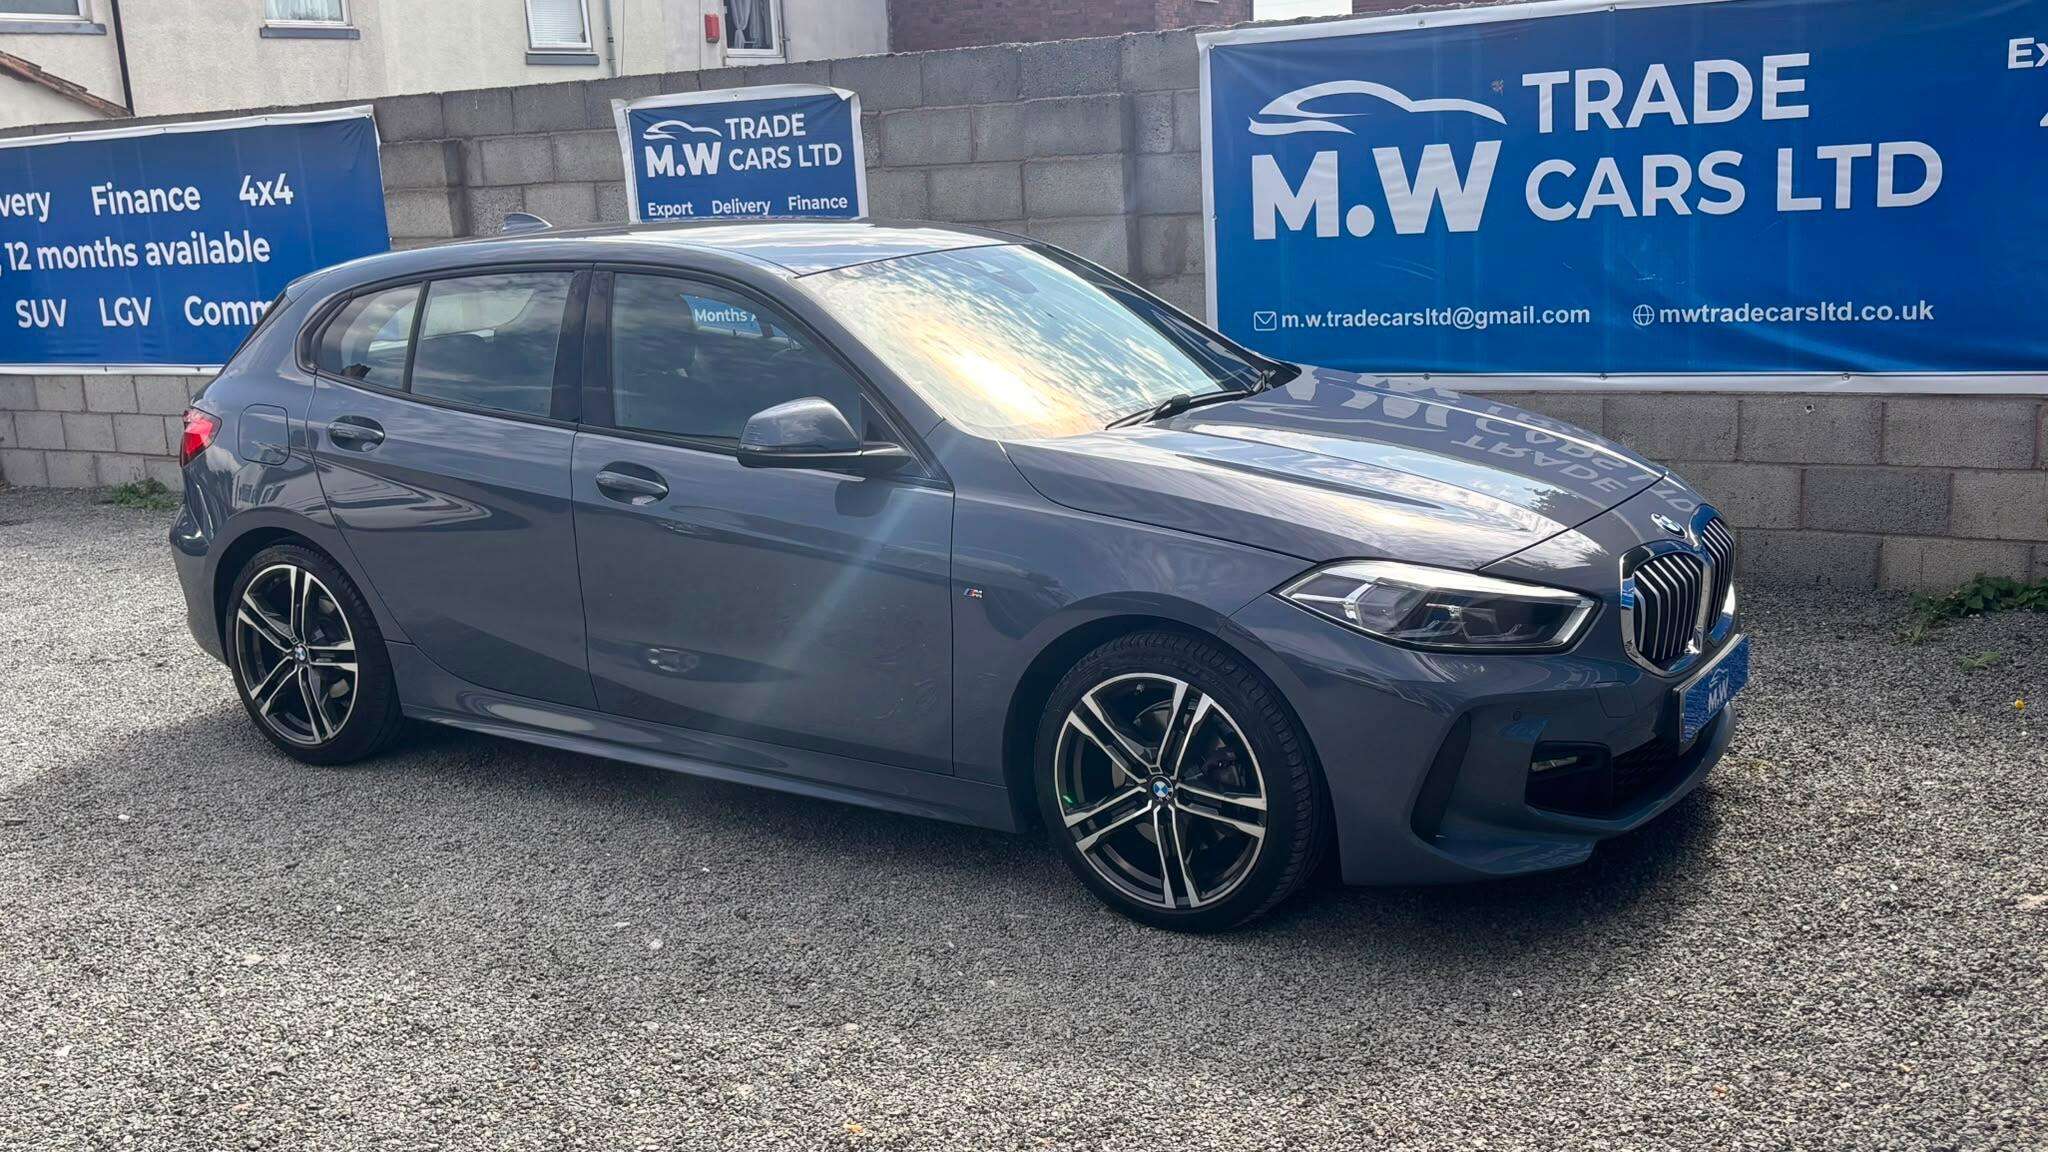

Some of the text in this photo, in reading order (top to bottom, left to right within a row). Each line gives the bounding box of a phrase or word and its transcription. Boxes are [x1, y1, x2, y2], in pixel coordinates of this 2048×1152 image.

[1522, 53, 1809, 133] TRADE
[725, 114, 805, 140] TRADE
[645, 142, 721, 177] M.W
[729, 143, 842, 170] CARS LTD
[92, 182, 200, 215] Finance
[240, 174, 293, 206] 4x4
[1252, 140, 1502, 239] M.W
[1526, 141, 1942, 221] CARS LTD
[648, 195, 847, 218] Export Delivery Finance
[5, 230, 270, 270] 12 months available
[16, 299, 66, 328] SUV
[99, 297, 151, 326] LGV
[694, 307, 748, 322] Months
[1282, 306, 1589, 329] m.w.tradecarsltd@gmail.com
[1660, 300, 1933, 322] mwtradecarsltd.co.uk
